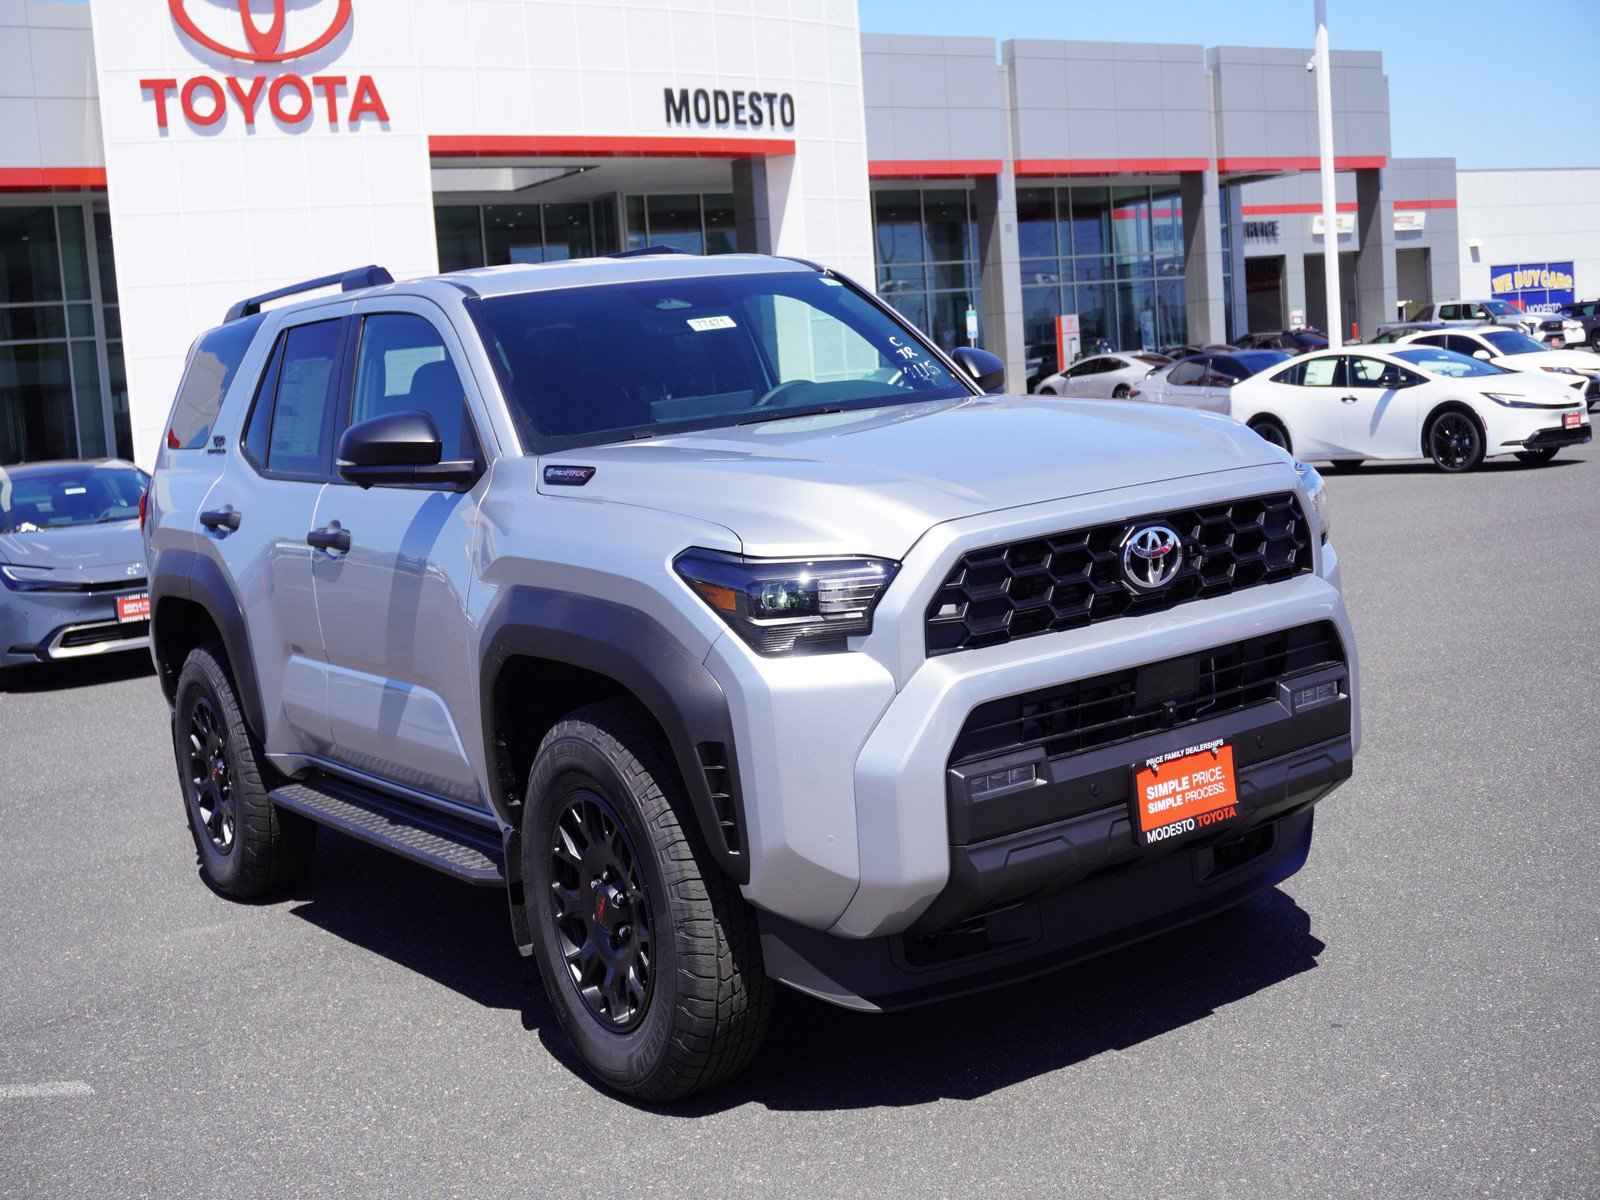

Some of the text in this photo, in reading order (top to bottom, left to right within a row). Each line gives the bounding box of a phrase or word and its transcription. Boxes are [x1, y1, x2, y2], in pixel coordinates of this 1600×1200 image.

[140, 74, 390, 128] TOYOTA
[664, 88, 795, 127] MODESTO
[1492, 269, 1573, 294] WE BUY CARS
[1146, 738, 1224, 767] PRICE FAMILY DEALERSHIPS
[1146, 766, 1226, 800] SIMPLE PRICE.
[1148, 782, 1227, 815] SIMPLE PROCESS.
[1146, 806, 1237, 843] MODESTO TOYOTA
